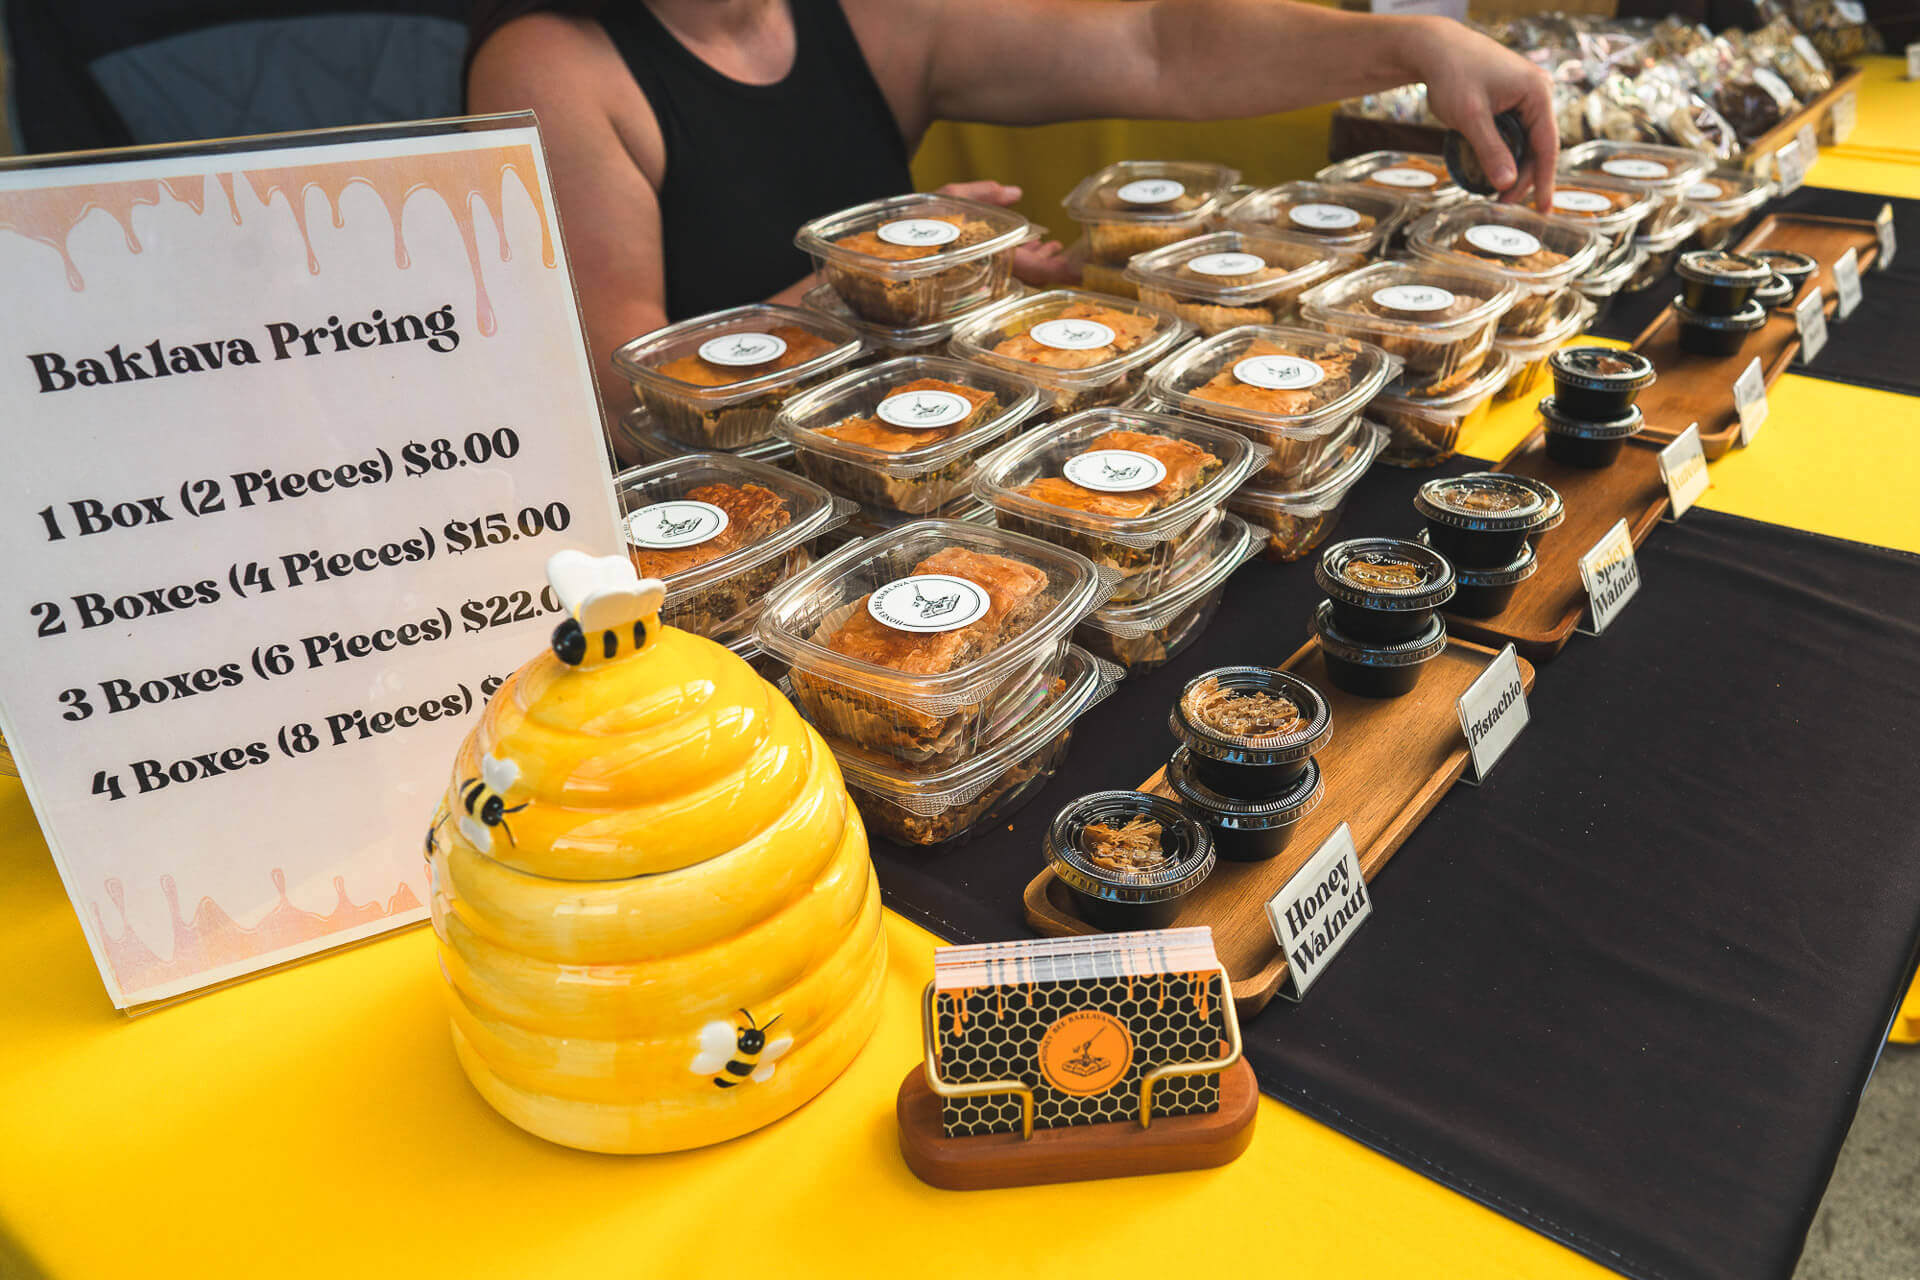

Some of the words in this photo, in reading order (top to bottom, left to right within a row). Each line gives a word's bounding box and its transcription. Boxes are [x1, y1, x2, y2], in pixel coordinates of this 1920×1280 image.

[26, 338, 262, 394] Baklava
[264, 304, 460, 361] Pricing
[37, 505, 66, 542] 1
[67, 495, 174, 537] Box
[180, 479, 226, 518] (2
[229, 447, 394, 508] Pieces)
[401, 427, 520, 478] $8.00
[30, 601, 67, 638] 2
[70, 580, 221, 630] Boxes
[228, 561, 276, 599] (4
[278, 526, 436, 588] Pieces)
[443, 501, 572, 556] $15.00
[1594, 540, 1627, 584] Spicy
[1594, 562, 1637, 616] Walnut
[58, 688, 94, 722] 3
[97, 663, 244, 714] Boxes
[251, 644, 295, 681] (6
[299, 607, 452, 669] Pieces)
[460, 584, 564, 634] $22.0
[91, 770, 127, 802] 4
[128, 742, 270, 794] Boxes
[277, 723, 320, 758] (8
[324, 683, 473, 746] Pieces)
[1470, 680, 1522, 747] Pistachio
[1284, 854, 1350, 941] Honey
[1290, 880, 1368, 975] Walnut
